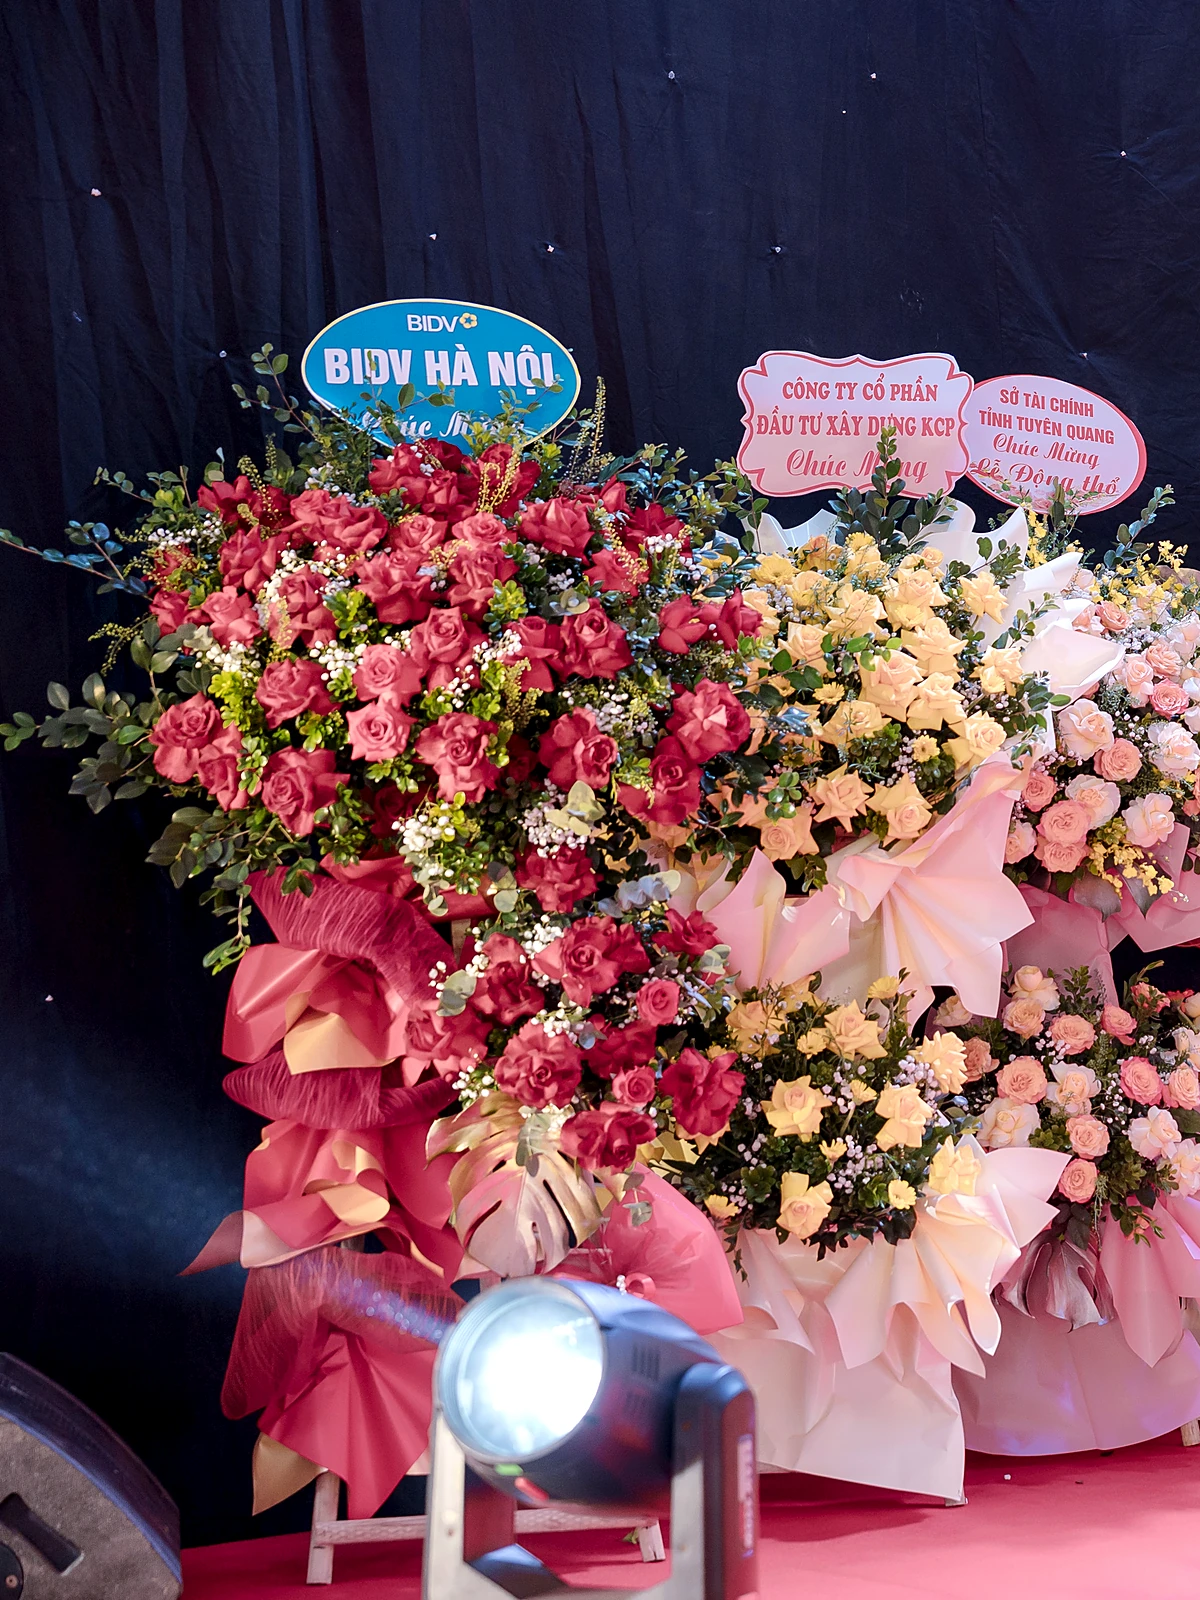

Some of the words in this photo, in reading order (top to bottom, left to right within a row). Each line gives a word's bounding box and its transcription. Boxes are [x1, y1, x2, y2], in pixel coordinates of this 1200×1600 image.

[407, 315, 459, 332] BIDV
[323, 348, 412, 385] BIDV
[424, 343, 478, 386] HÀ
[487, 344, 555, 395] NỘI
[782, 376, 830, 400] CÔNG
[835, 382, 858, 400] TY
[862, 372, 885, 401] CỔ
[890, 375, 938, 402] PHẦN
[1000, 386, 1020, 406] SỞ
[1023, 392, 1046, 410] TÀI
[1049, 397, 1094, 418] CHÍNH
[756, 405, 794, 435] ĐẦU
[798, 411, 823, 435] TƯ
[826, 409, 864, 436] XÂY
[921, 417, 956, 437] KCP
[979, 407, 1012, 429] TỈNH
[1016, 416, 1062, 437] TUYÊN
[1066, 424, 1115, 445] QUANG
[786, 448, 848, 477] Chúc
[853, 450, 929, 484] Mng
[992, 433, 1039, 458] Chúc
[1043, 441, 1100, 470] Mừng
[970, 457, 1003, 478] Lễ
[1083, 476, 1121, 495] thổ
